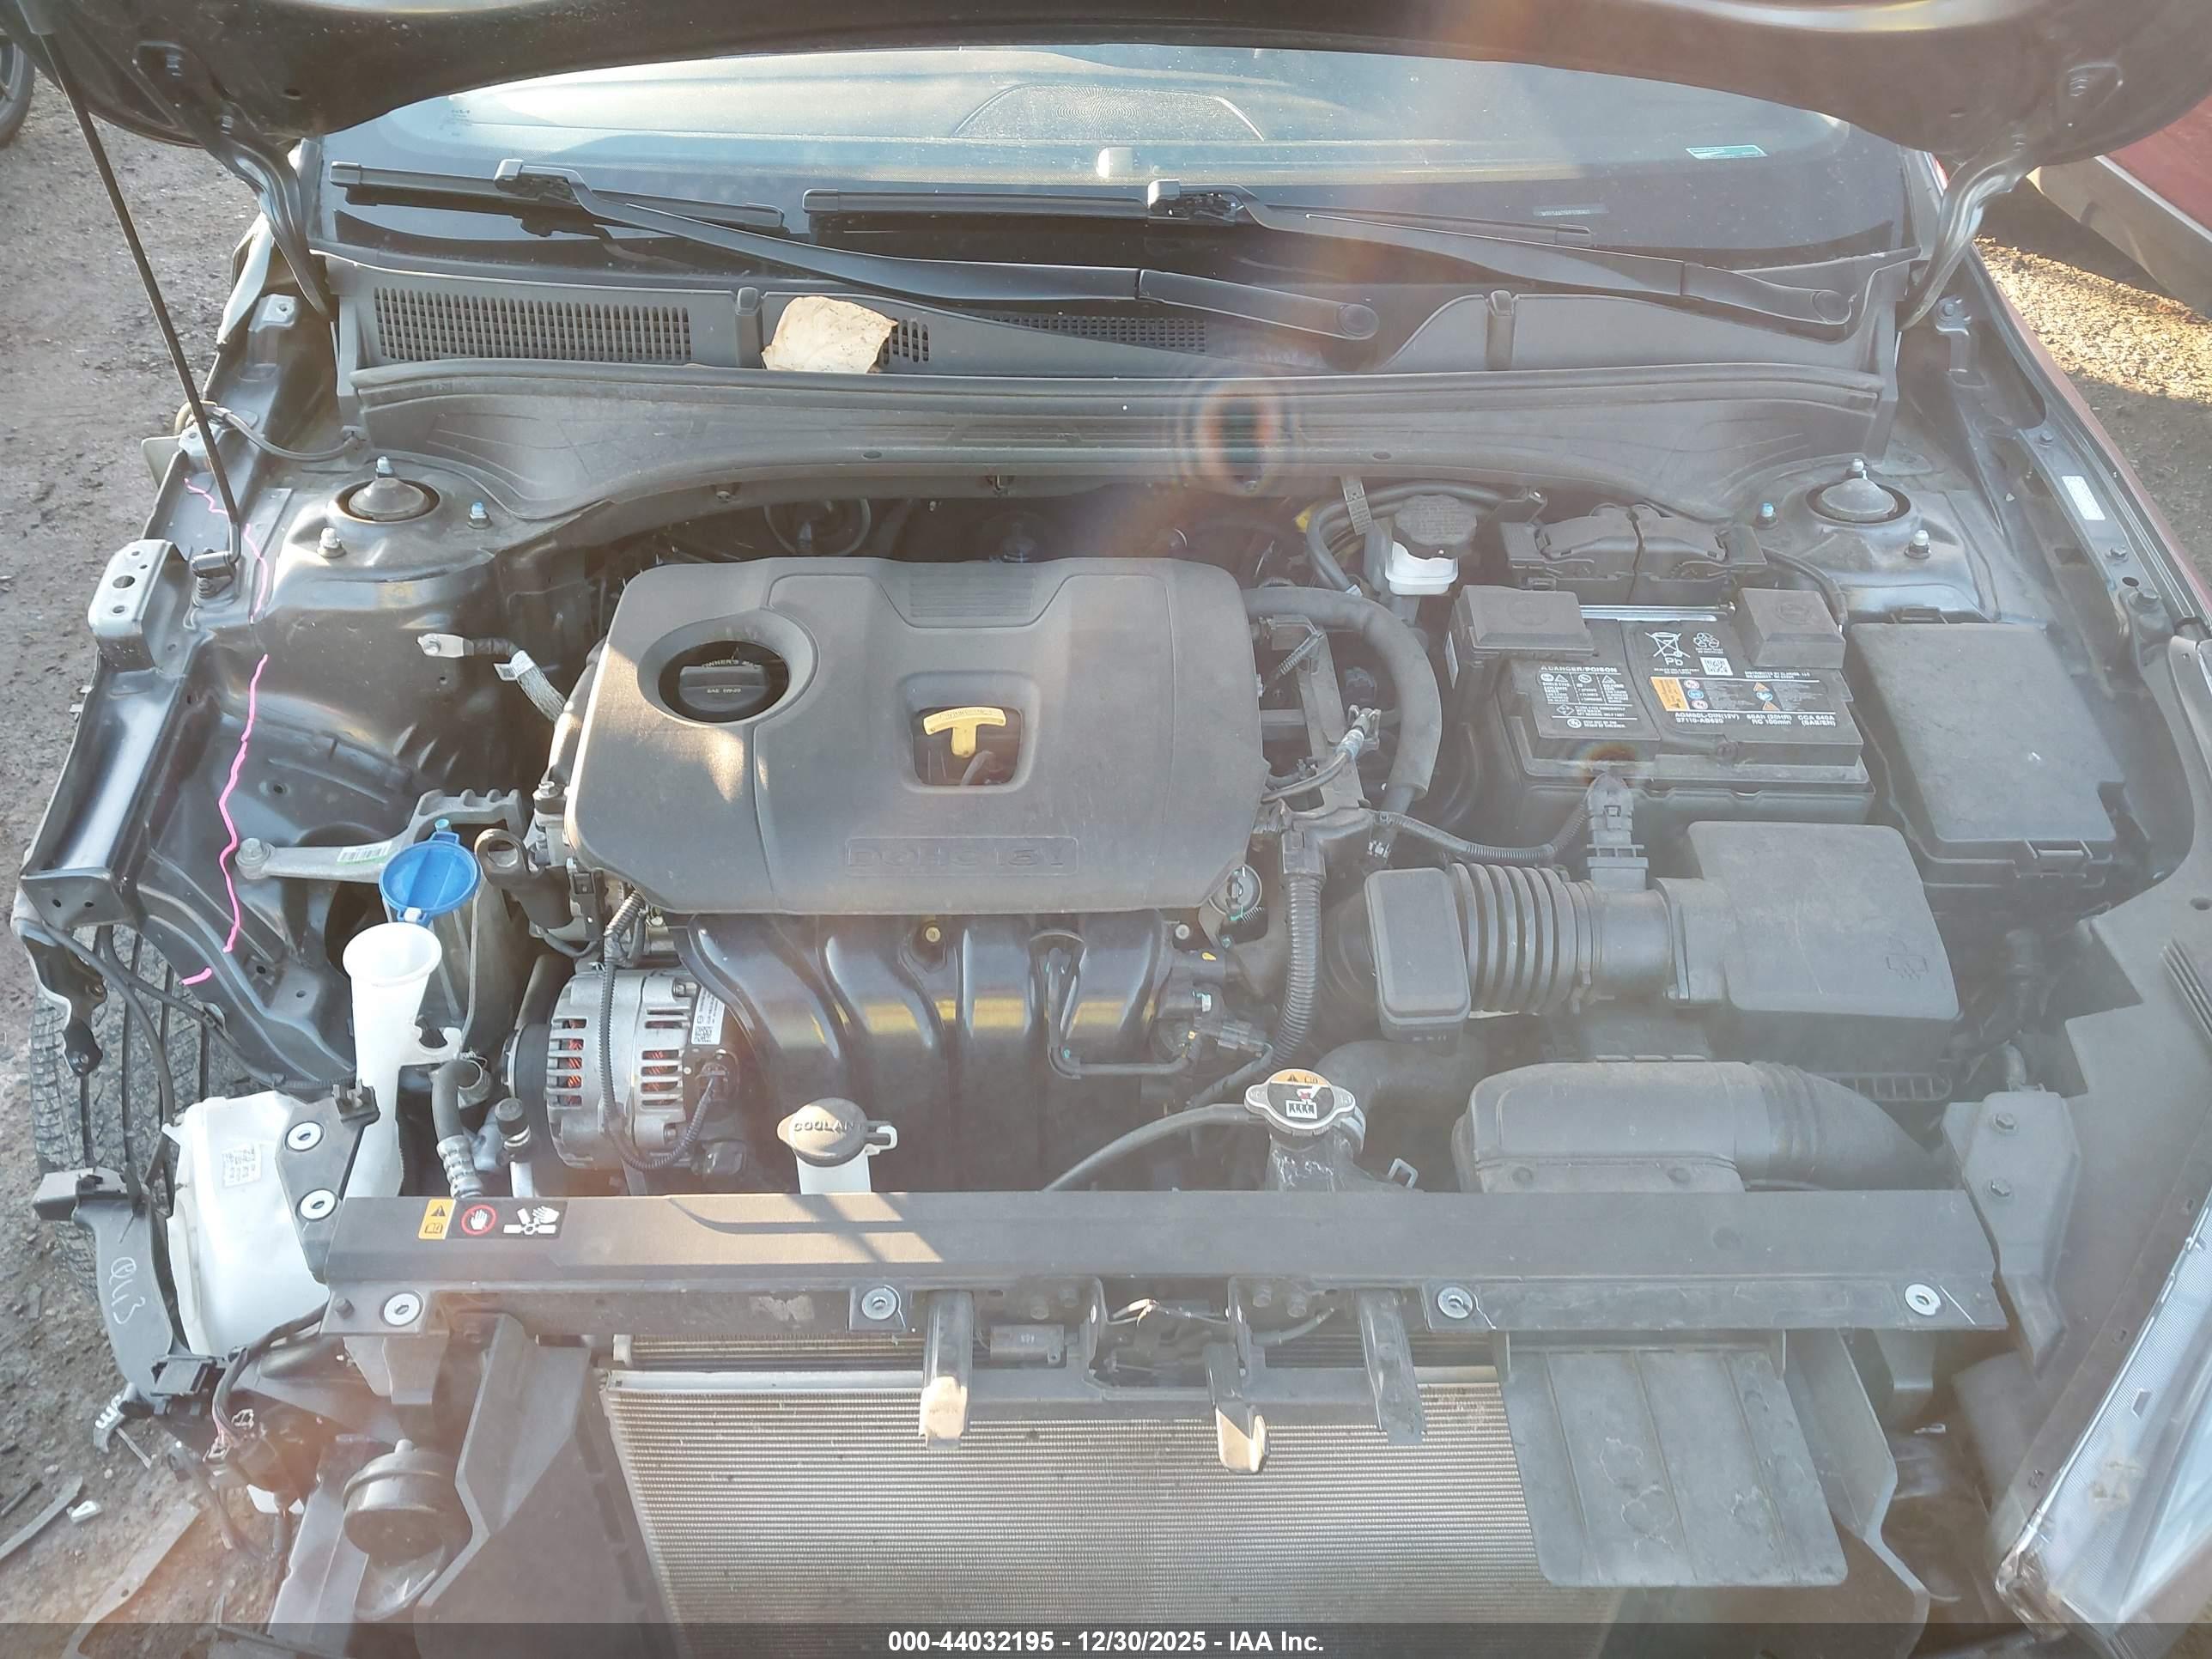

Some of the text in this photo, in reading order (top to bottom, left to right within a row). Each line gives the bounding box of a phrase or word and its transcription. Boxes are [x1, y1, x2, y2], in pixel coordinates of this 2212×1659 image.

[1665, 658, 1684, 666] Pb
[848, 847, 986, 866] DOHC
[793, 1119, 864, 1134] COOLANT
